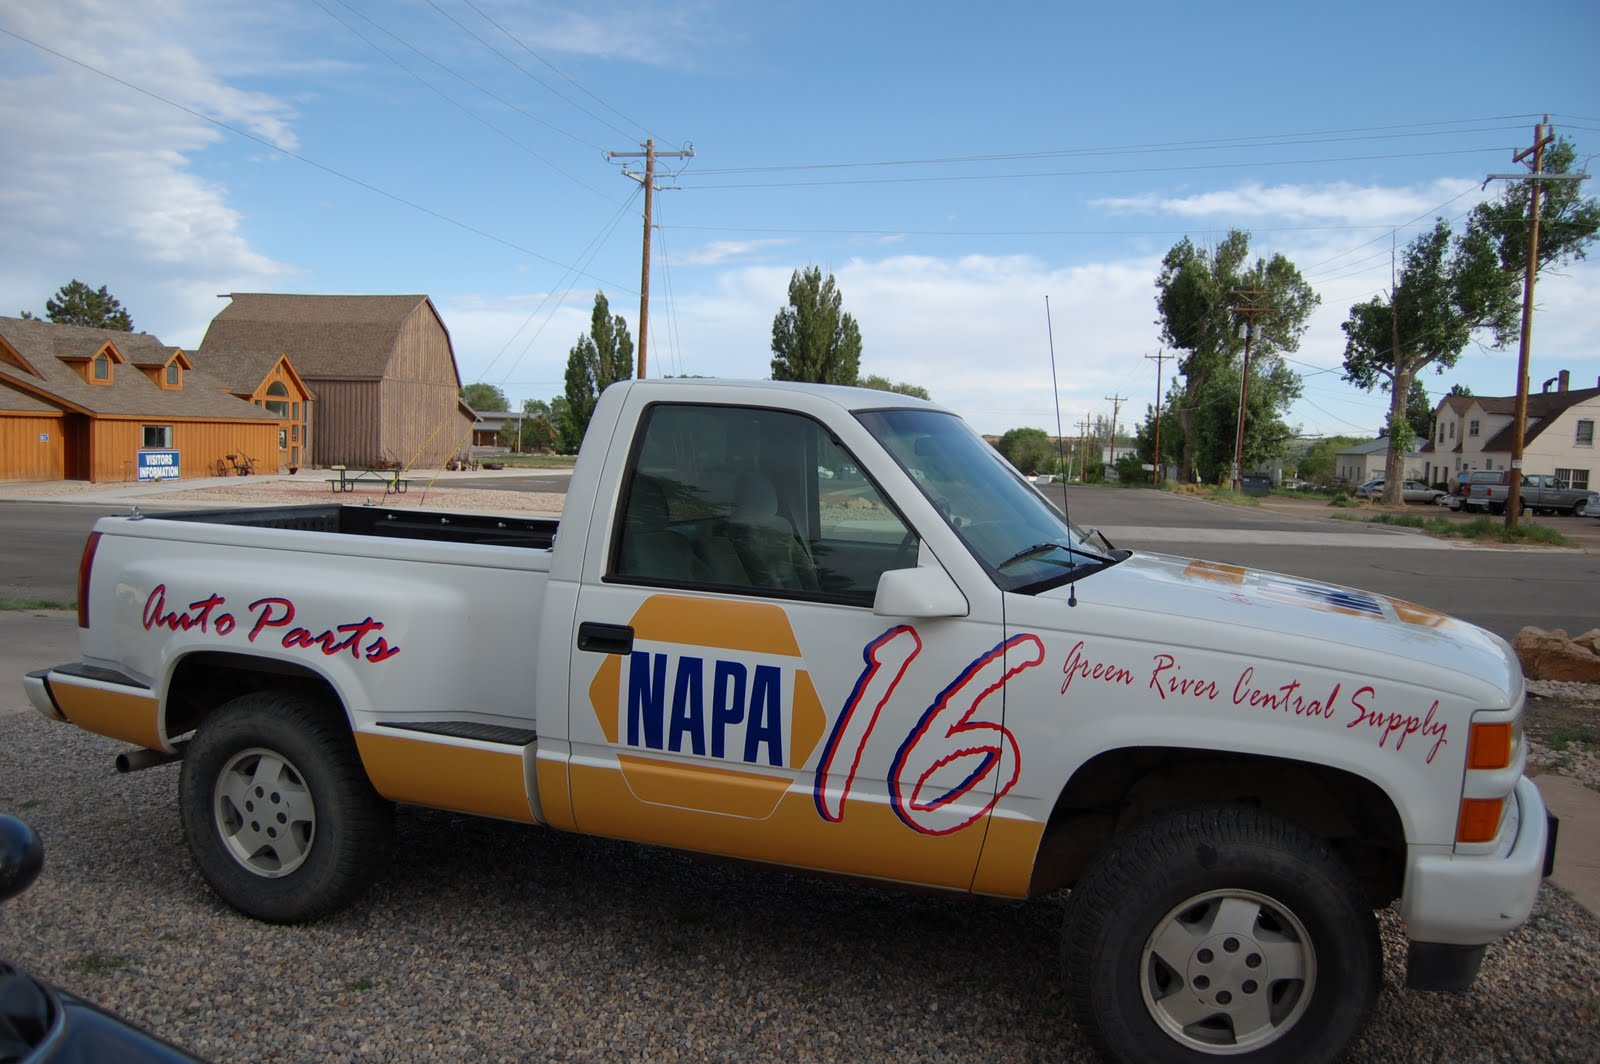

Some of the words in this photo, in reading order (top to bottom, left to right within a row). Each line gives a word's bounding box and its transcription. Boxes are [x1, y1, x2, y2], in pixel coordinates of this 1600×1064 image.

[139, 466, 179, 478] INFORMATION
[145, 454, 173, 466] VISITORS
[143, 584, 236, 636] Auto
[248, 597, 400, 664] Parts
[627, 650, 783, 767] NAPA
[814, 624, 1046, 837] 16
[1061, 641, 1134, 695] Green
[1149, 653, 1219, 700] River
[1232, 667, 1341, 719] Central
[1346, 686, 1448, 764] Supply
